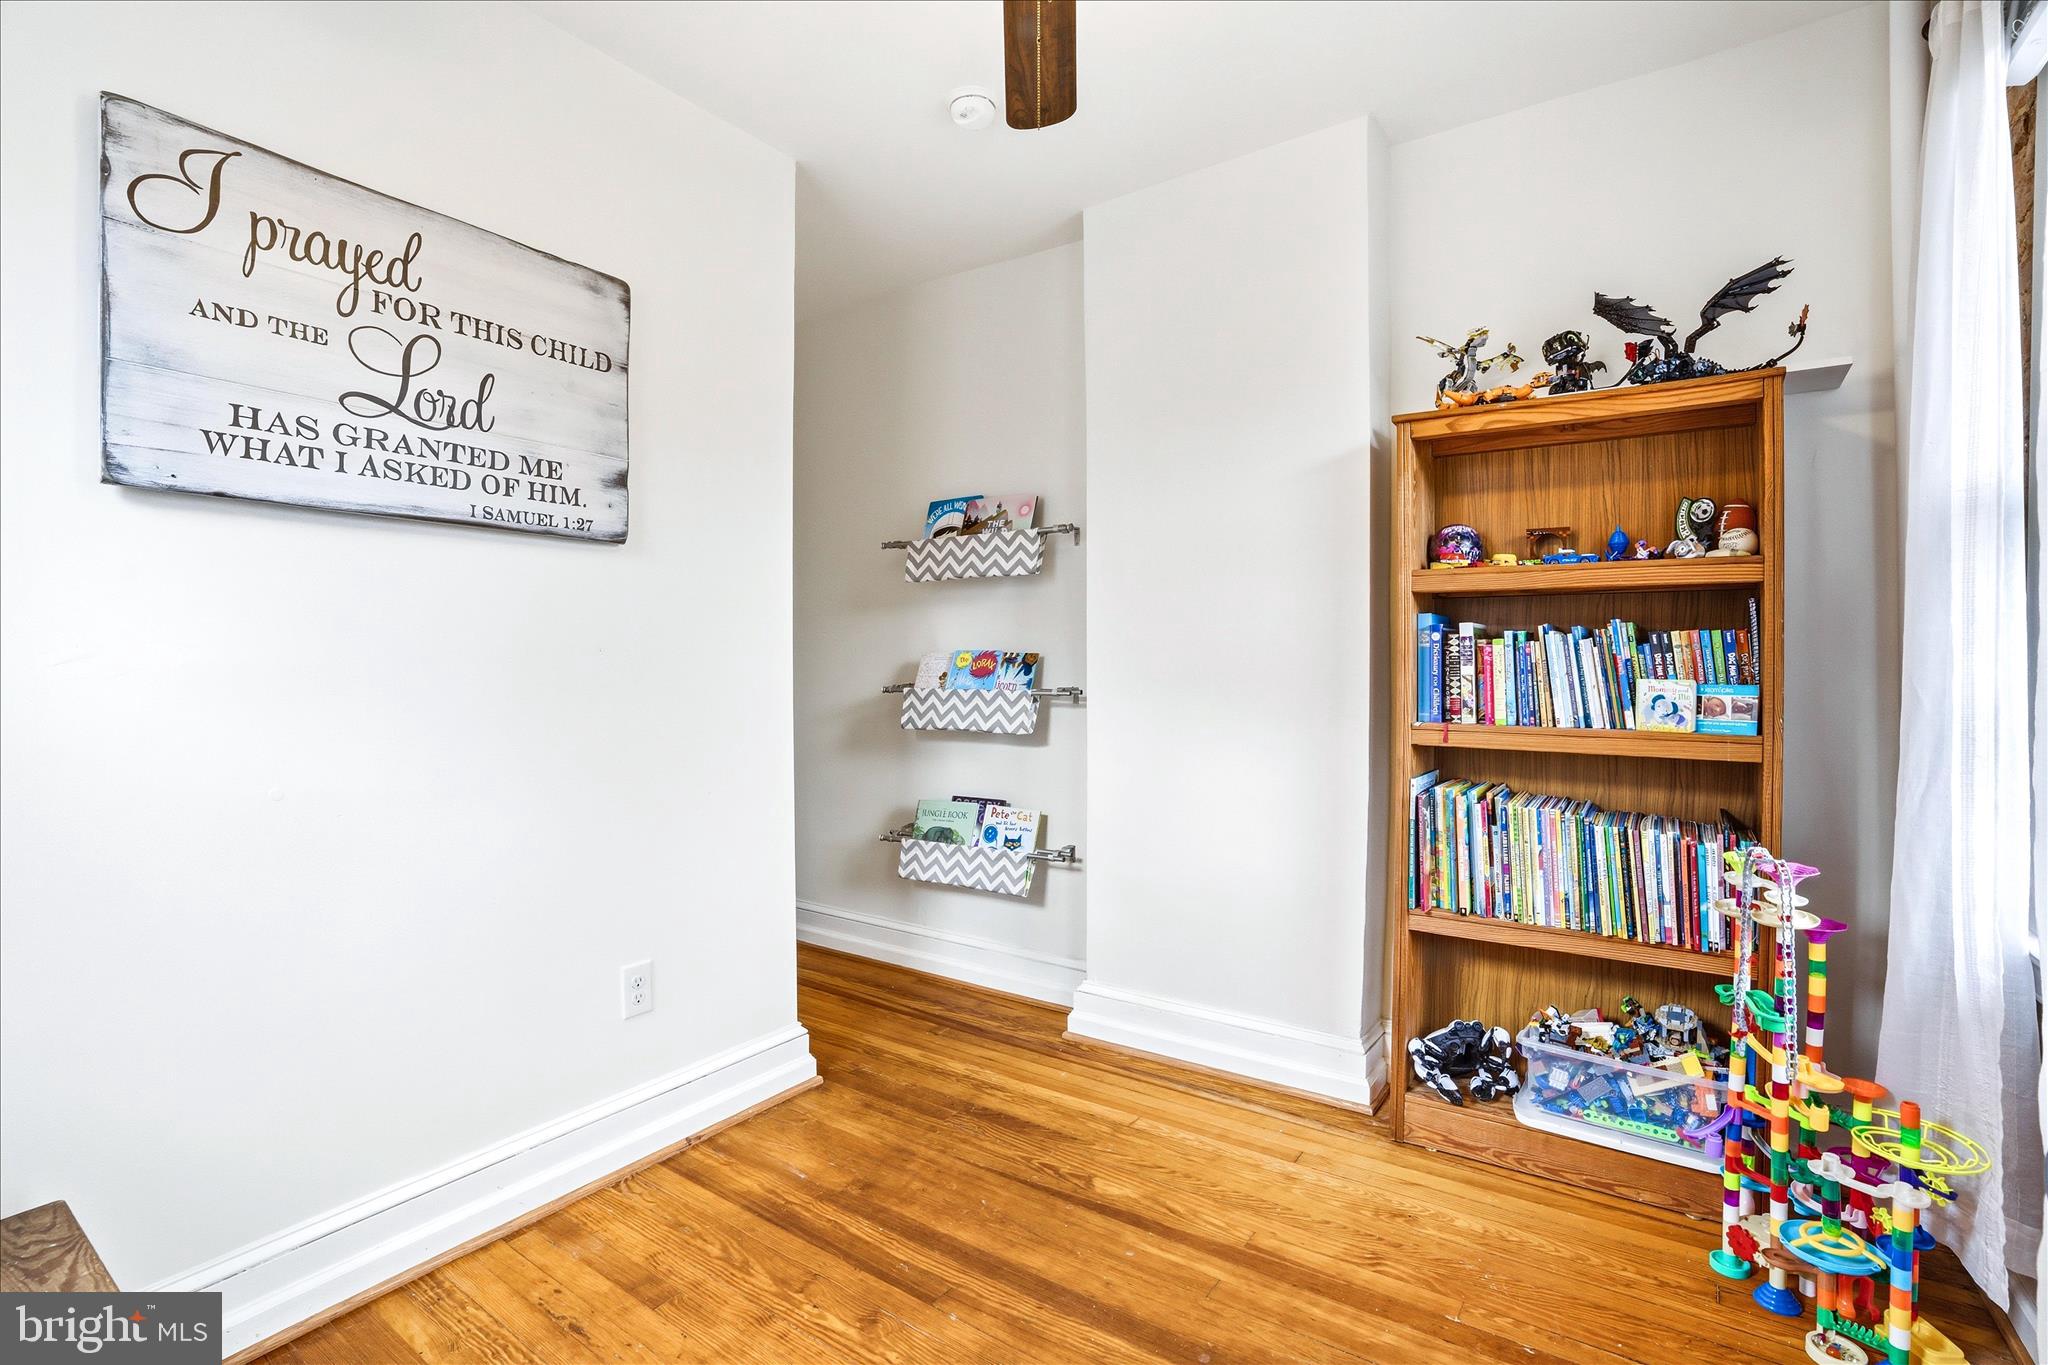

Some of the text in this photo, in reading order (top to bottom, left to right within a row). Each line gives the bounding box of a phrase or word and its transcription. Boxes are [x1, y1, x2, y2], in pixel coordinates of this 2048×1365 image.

[126, 148, 423, 318] I prayed
[188, 297, 329, 346] AND THE
[370, 289, 613, 373] FOR THIS CHILD
[338, 325, 495, 432] Lord
[228, 402, 563, 480] HAS GRANTED ME
[199, 428, 587, 508] WHAT I ASKED OF HIM.
[470, 504, 594, 532] I SAMUEL 1:27
[943, 503, 953, 511] ALL
[987, 519, 1005, 528] THE
[972, 658, 996, 671] LORAX
[1431, 643, 1440, 675] Dictionary
[922, 809, 969, 819] JUNGLE BOOK
[991, 806, 1010, 820] Pete
[1016, 810, 1033, 822] Cat
